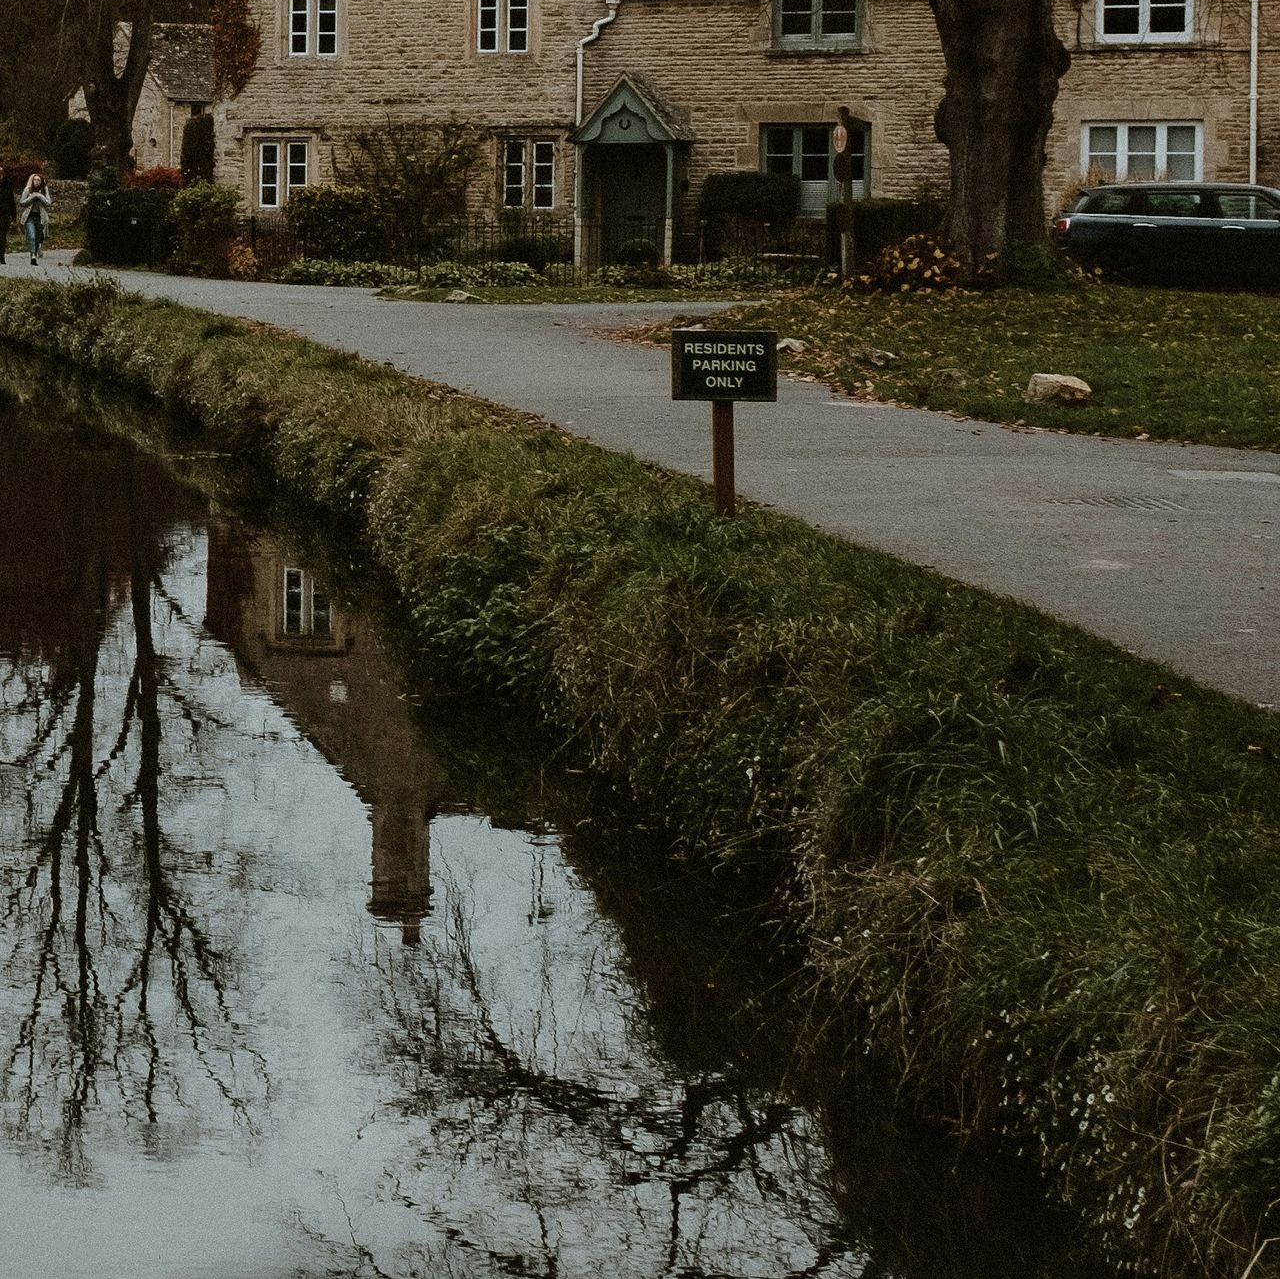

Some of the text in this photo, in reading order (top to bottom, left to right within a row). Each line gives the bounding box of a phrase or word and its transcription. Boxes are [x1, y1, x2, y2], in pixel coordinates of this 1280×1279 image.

[684, 343, 764, 355] RESIDENTS
[692, 359, 757, 372] PARKING
[705, 376, 744, 388] ONLY
